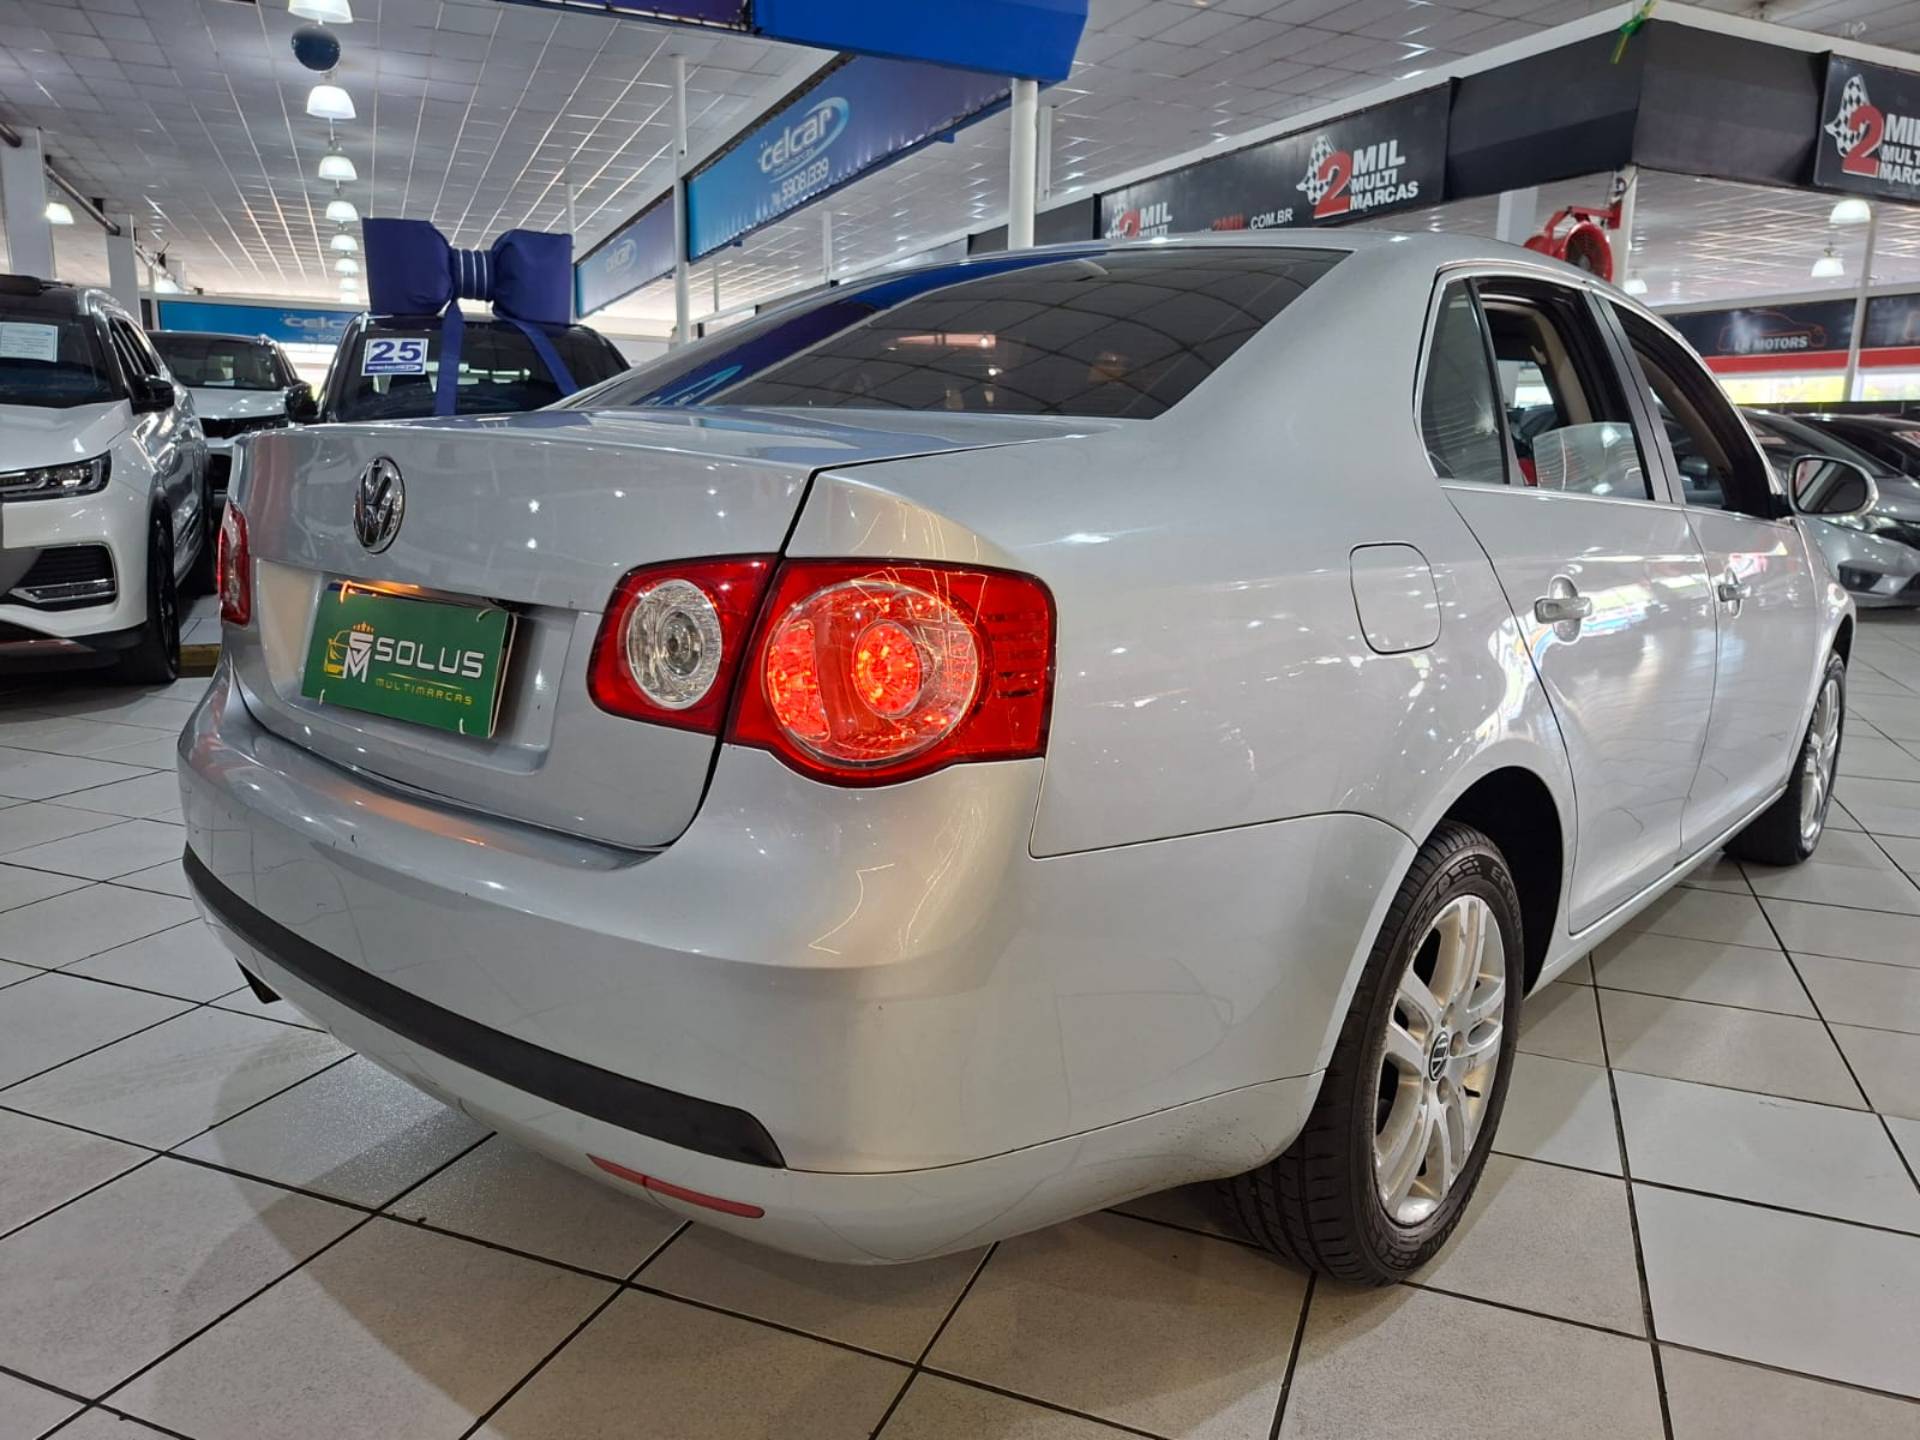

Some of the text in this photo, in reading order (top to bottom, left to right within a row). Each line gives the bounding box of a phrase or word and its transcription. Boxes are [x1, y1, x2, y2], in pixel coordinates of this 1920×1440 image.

[760, 107, 832, 174] celcar
[1842, 104, 1884, 178] 2
[1313, 139, 1406, 219] 2 MIL
[1350, 168, 1398, 193] MULTI
[1350, 181, 1419, 211] MARCAS
[1139, 202, 1173, 231] MIL
[369, 341, 422, 362] 25
[1753, 336, 1808, 351] MOTORS
[374, 636, 485, 679] SOLUS
[375, 677, 473, 706] MULTIMARCAS
